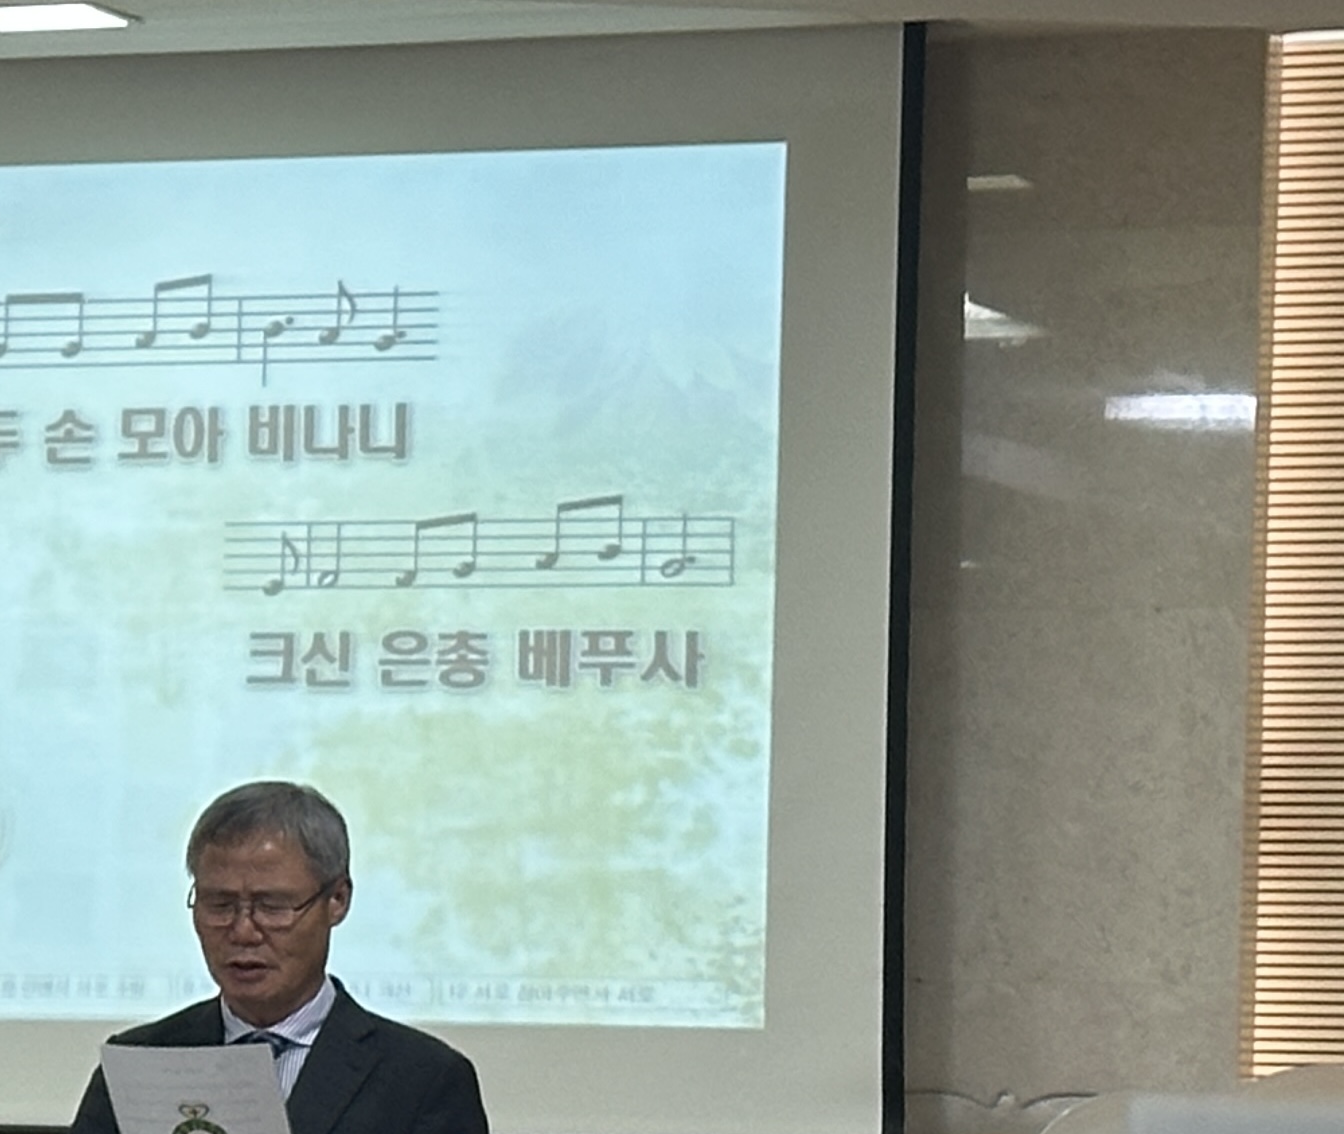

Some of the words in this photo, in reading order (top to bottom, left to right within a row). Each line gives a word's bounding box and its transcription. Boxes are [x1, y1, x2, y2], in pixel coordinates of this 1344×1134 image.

[43, 408, 96, 465] 손
[117, 405, 226, 464] 모아
[247, 402, 409, 463] 비나니
[246, 630, 352, 688] 크신
[378, 630, 491, 689] 은총
[517, 628, 707, 688] 베푸사
